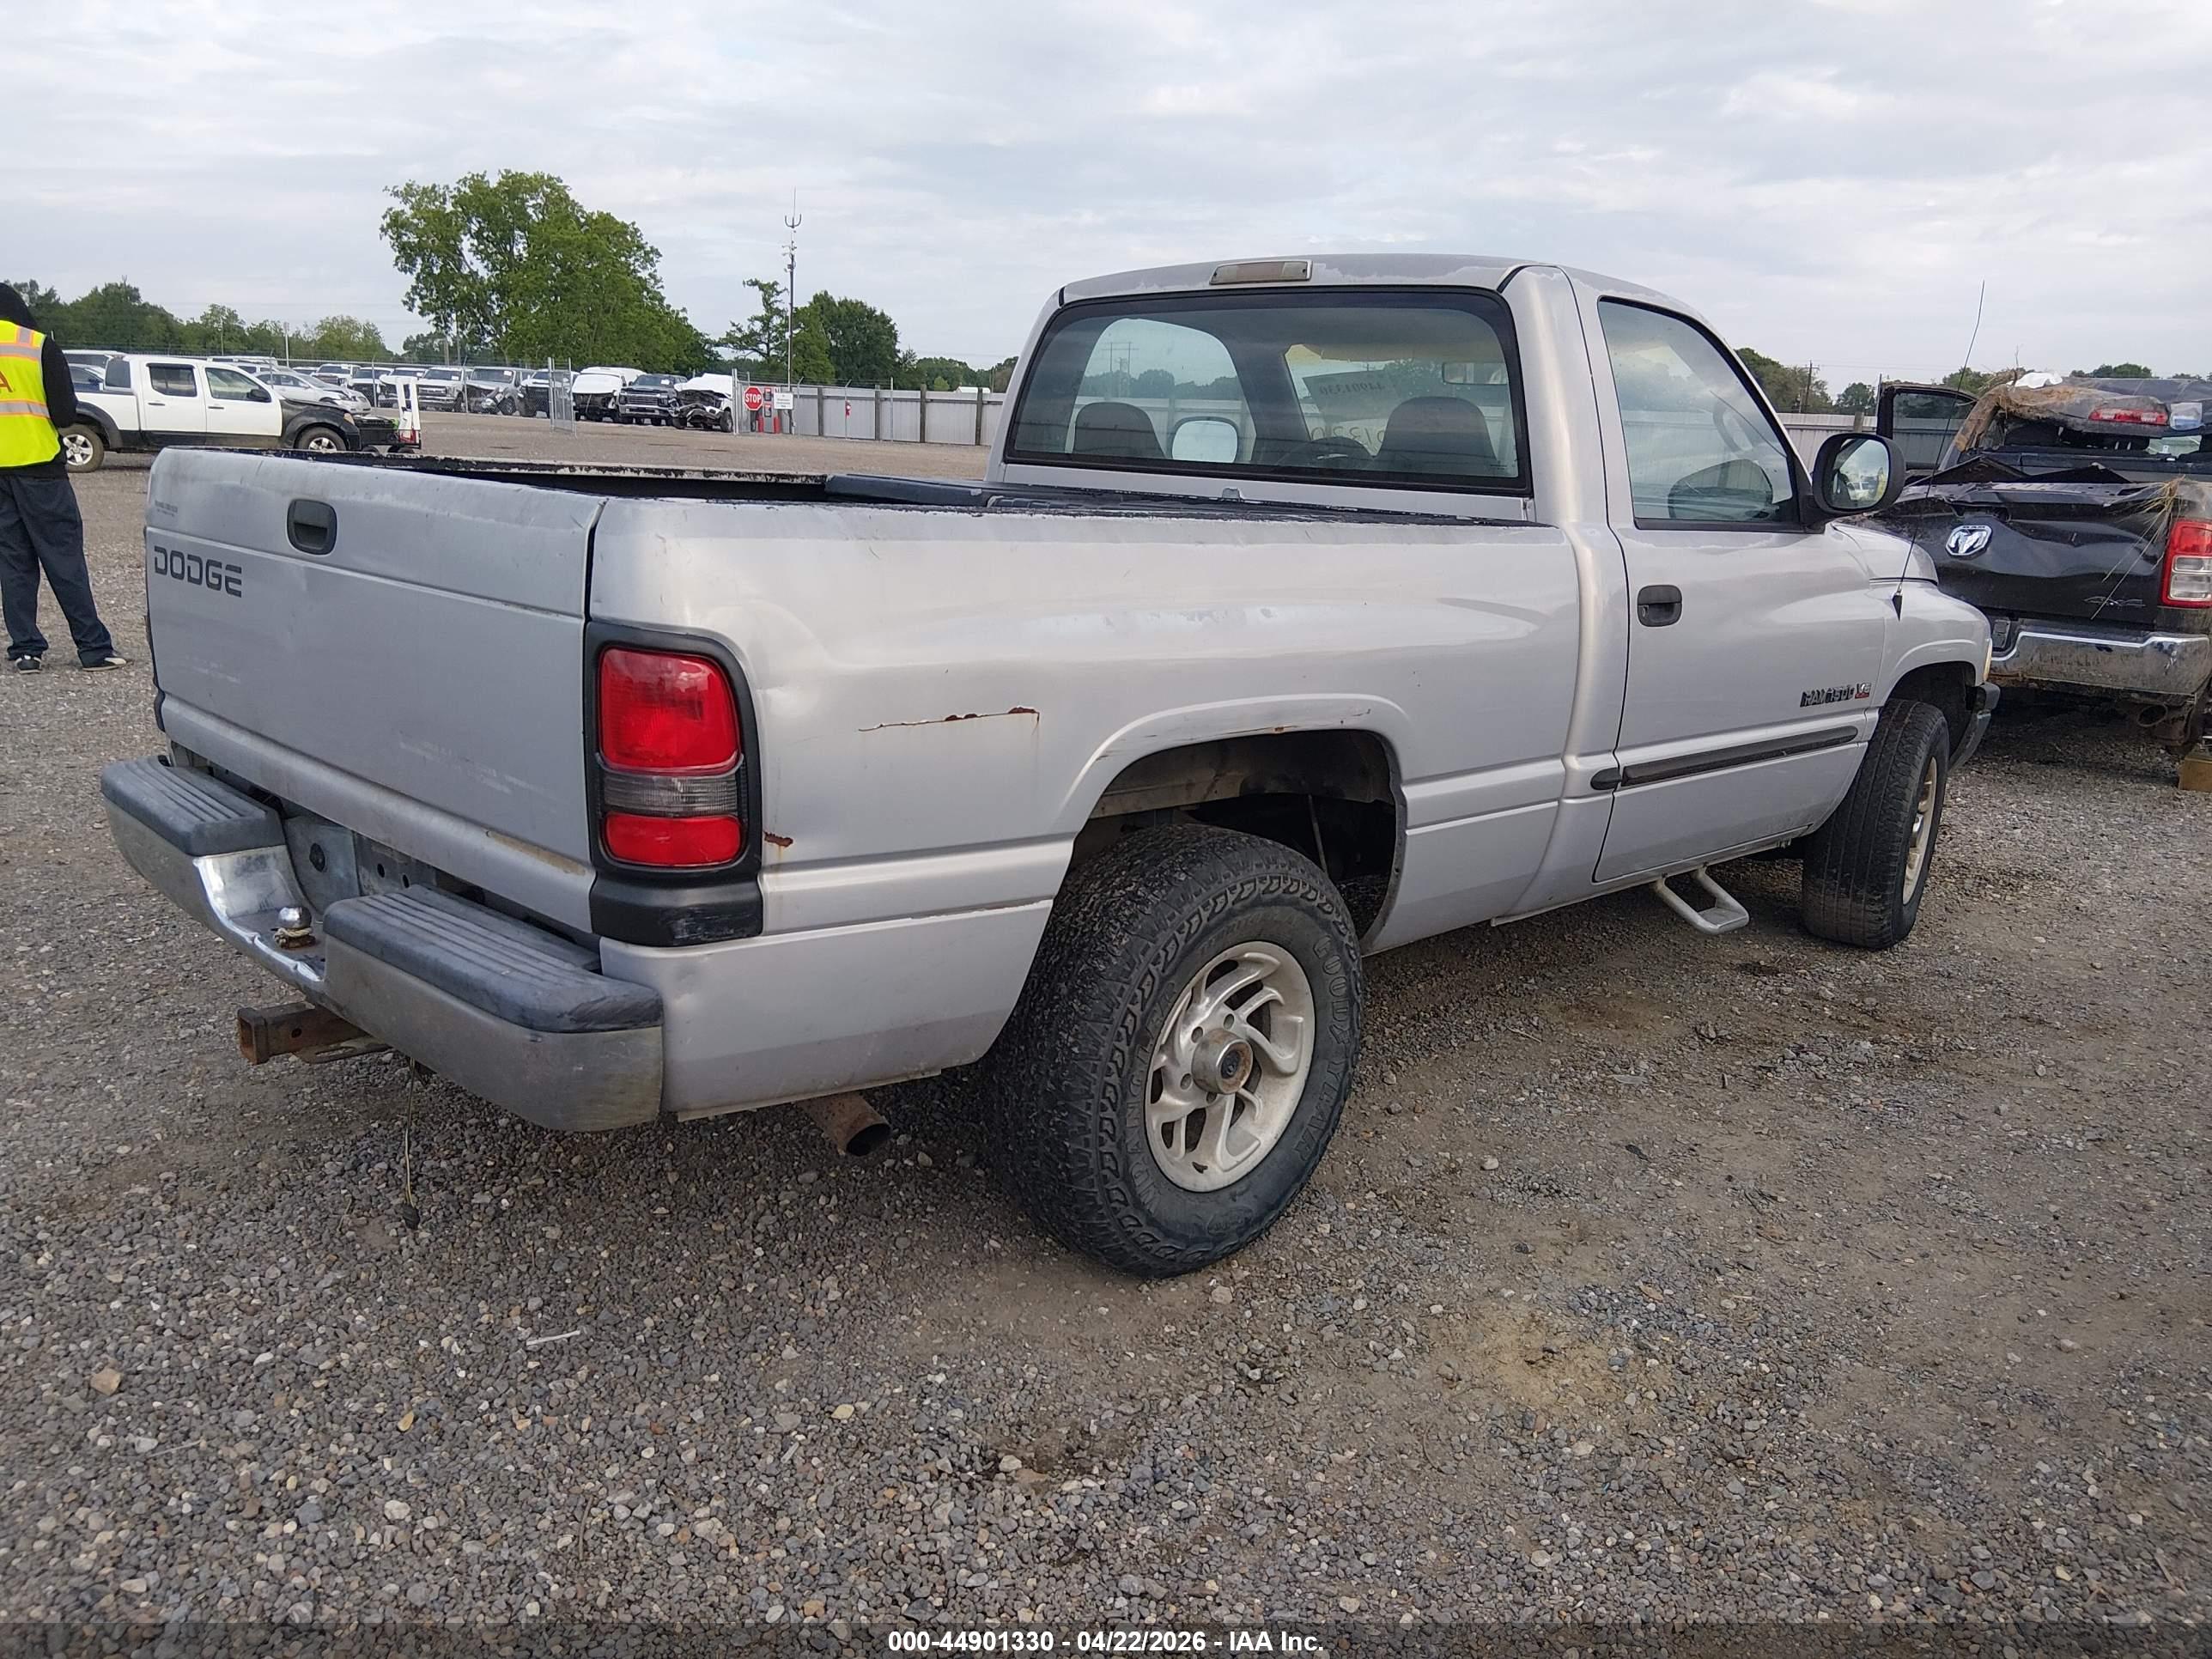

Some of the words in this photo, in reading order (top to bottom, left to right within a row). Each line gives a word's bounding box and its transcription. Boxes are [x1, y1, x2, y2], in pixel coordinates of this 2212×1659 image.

[744, 392, 762, 404] STOP
[154, 545, 242, 598] DODGE
[1800, 688, 1827, 708] RAM
